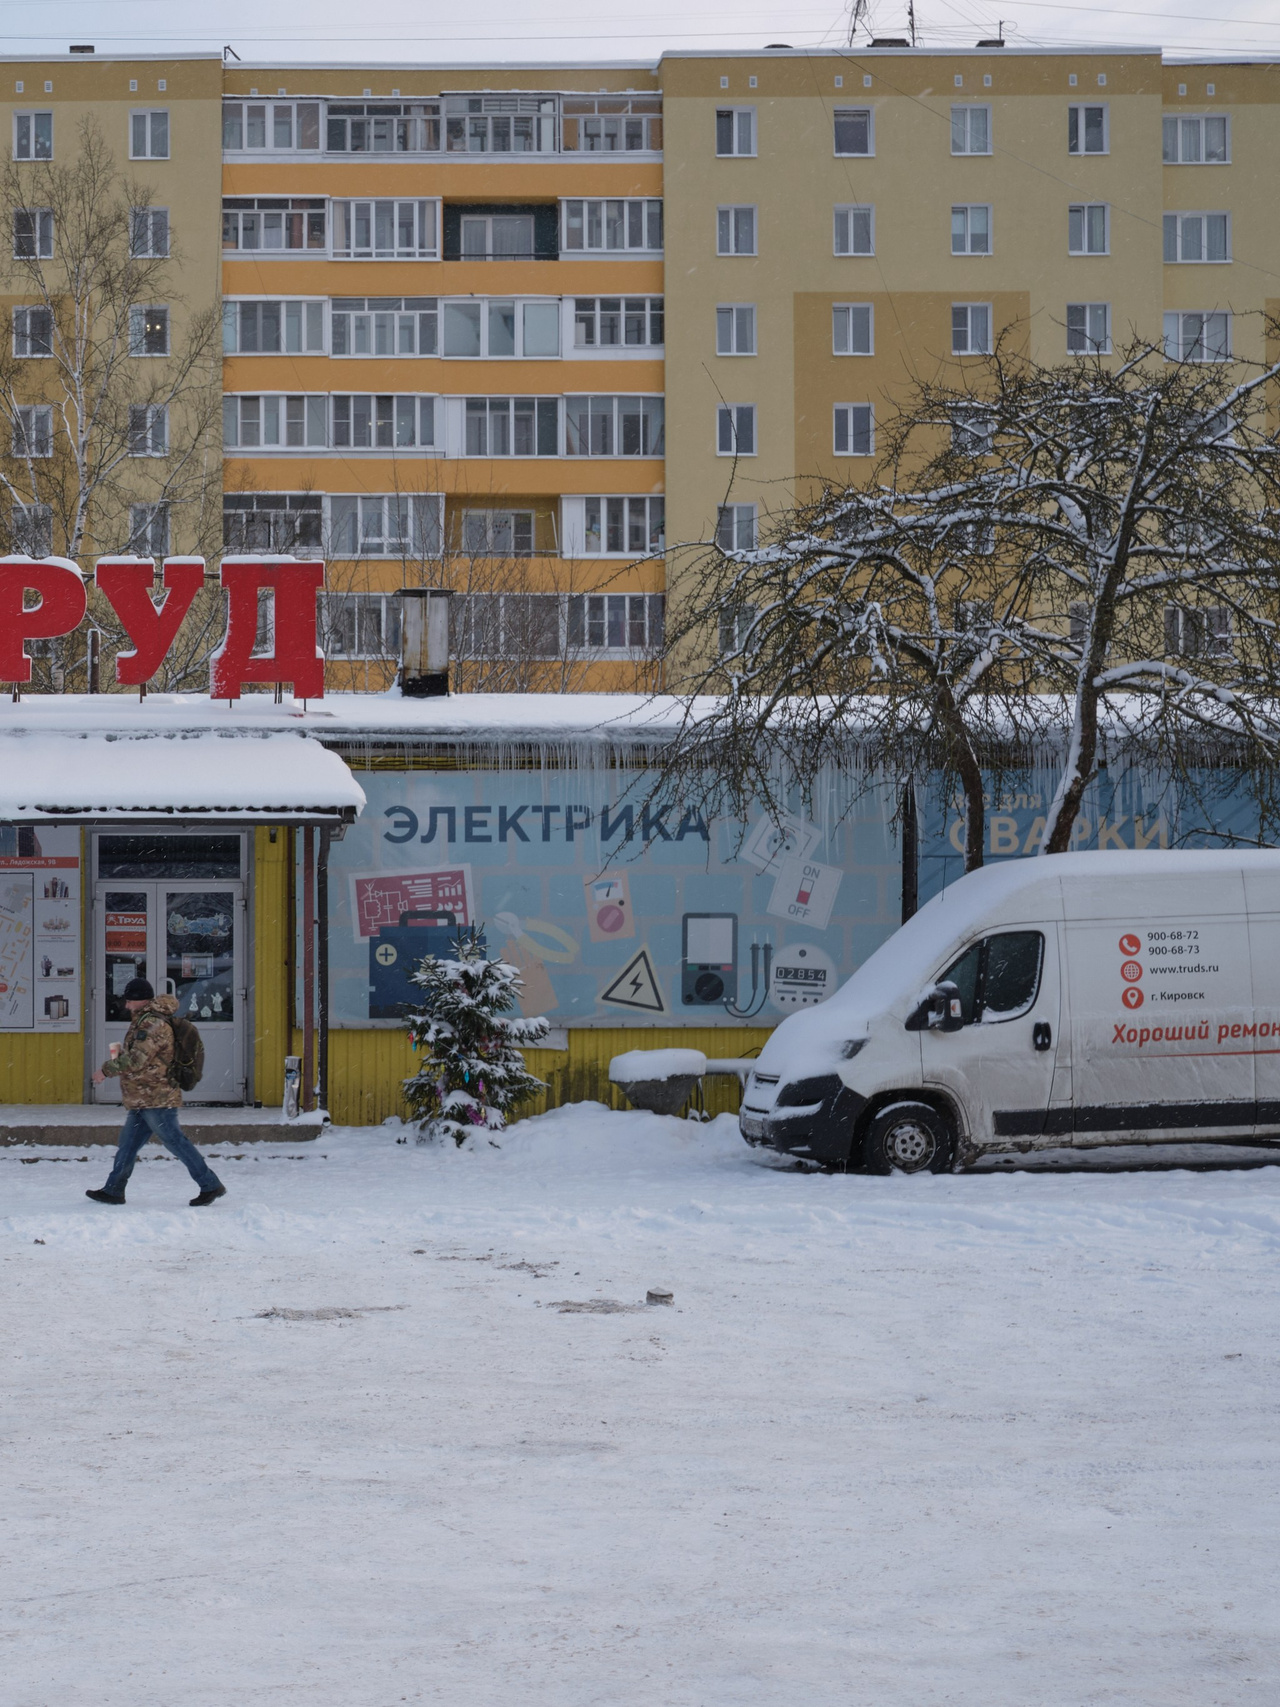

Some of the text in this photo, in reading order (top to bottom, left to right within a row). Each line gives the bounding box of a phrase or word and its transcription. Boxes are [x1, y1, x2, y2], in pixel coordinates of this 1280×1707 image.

[383, 804, 711, 844] ЭЛЕКТРИКА
[802, 865, 821, 879] ON
[787, 903, 811, 918] OFF
[1147, 930, 1199, 941] 900-68-72
[1148, 944, 1200, 956] 900-68-73
[777, 967, 825, 980] 02854
[1149, 963, 1219, 975] www.truds.ru
[1151, 991, 1205, 1002] г. Кировск
[1111, 1020, 1210, 1048] Хороший
